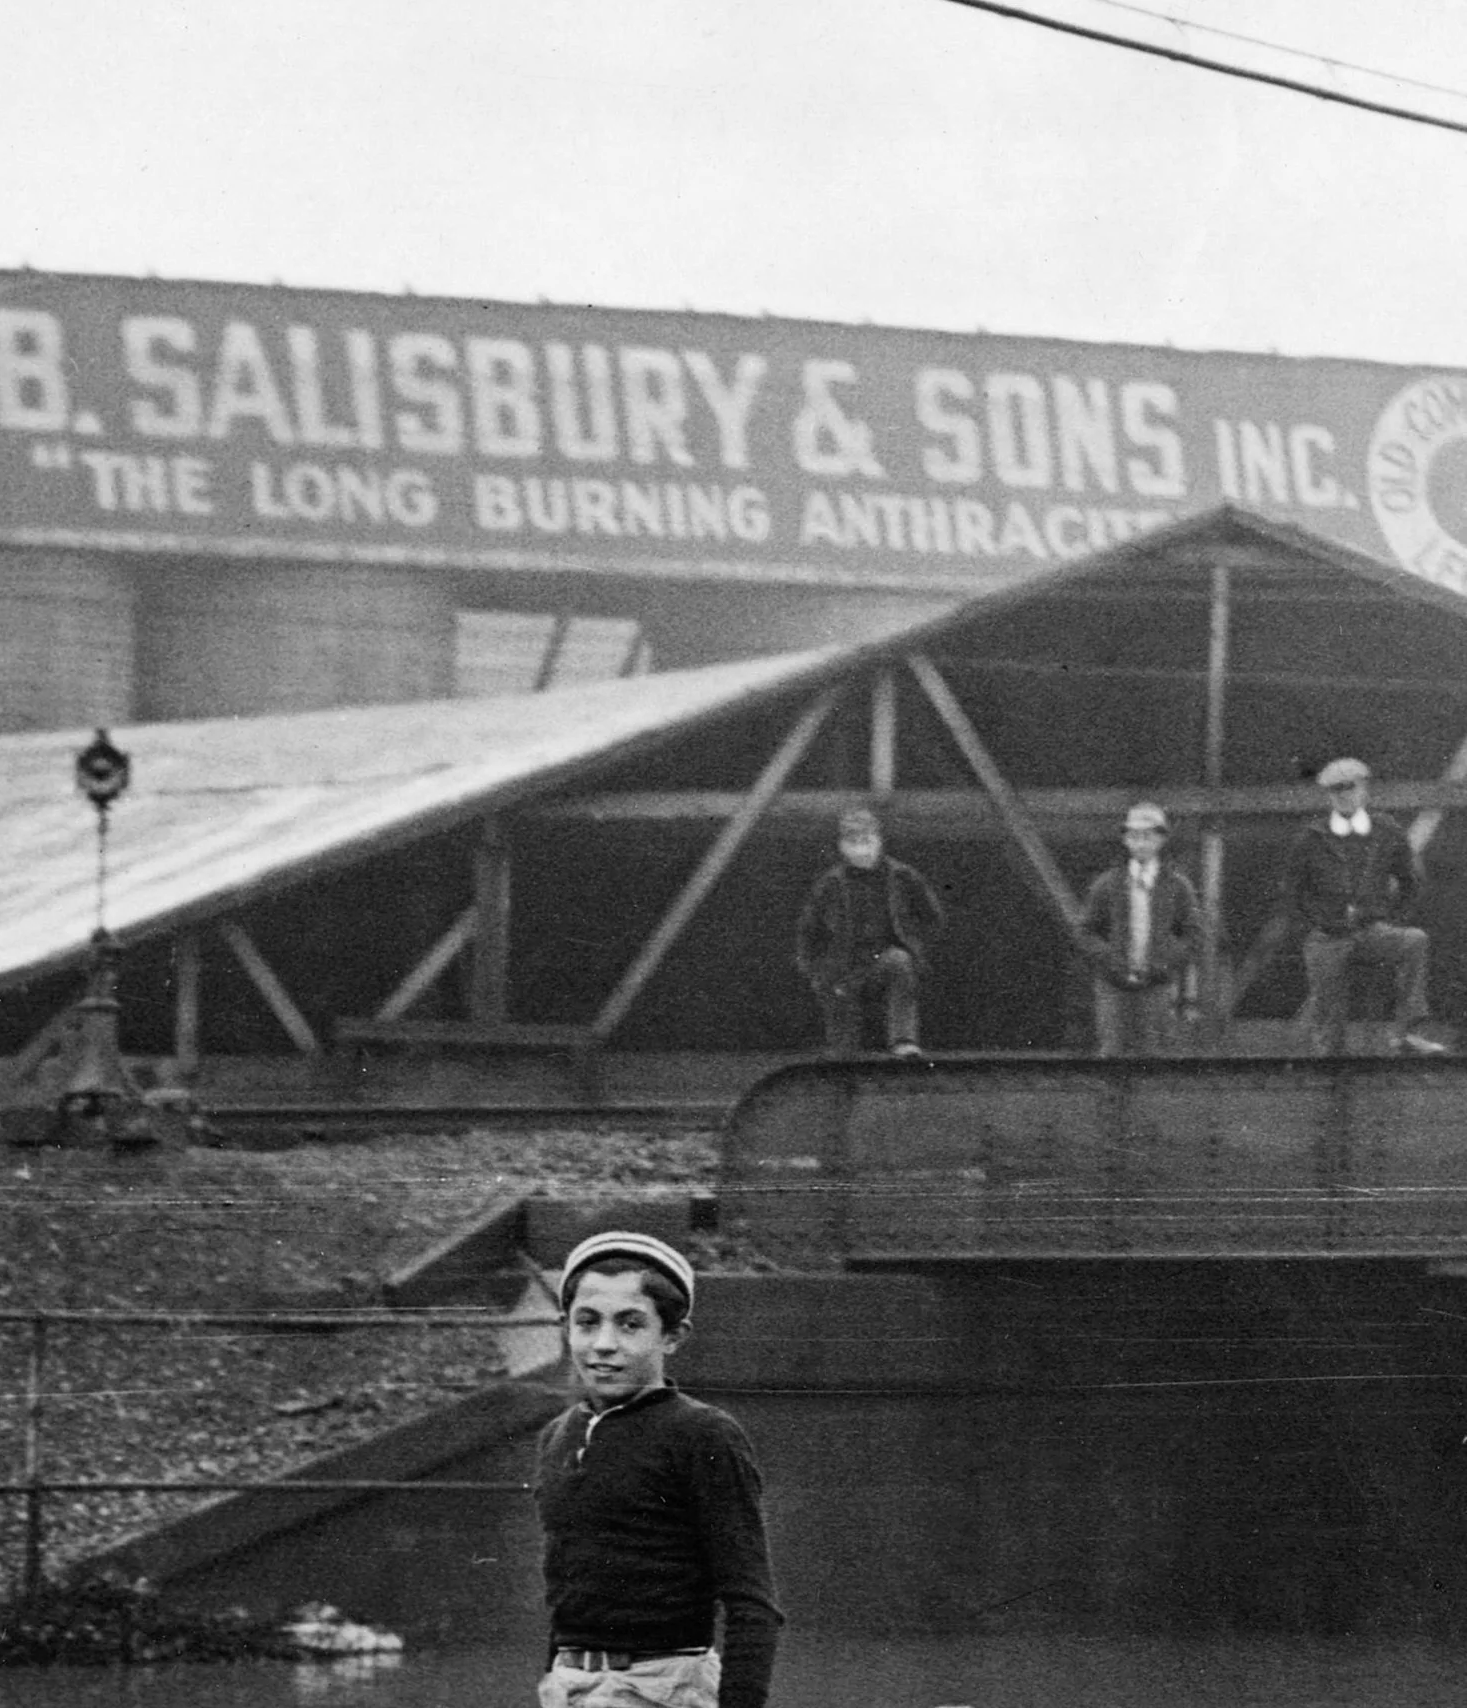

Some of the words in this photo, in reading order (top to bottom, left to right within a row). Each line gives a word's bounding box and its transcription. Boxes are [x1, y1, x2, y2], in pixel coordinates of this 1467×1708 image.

[120, 314, 768, 469] SALISBURY
[792, 358, 885, 480] &
[917, 366, 1187, 498] SONS
[1214, 416, 1360, 511] INC.
[251, 460, 439, 528] LONG
[474, 473, 771, 545] BURNING
[1379, 440, 1418, 514] OLD
